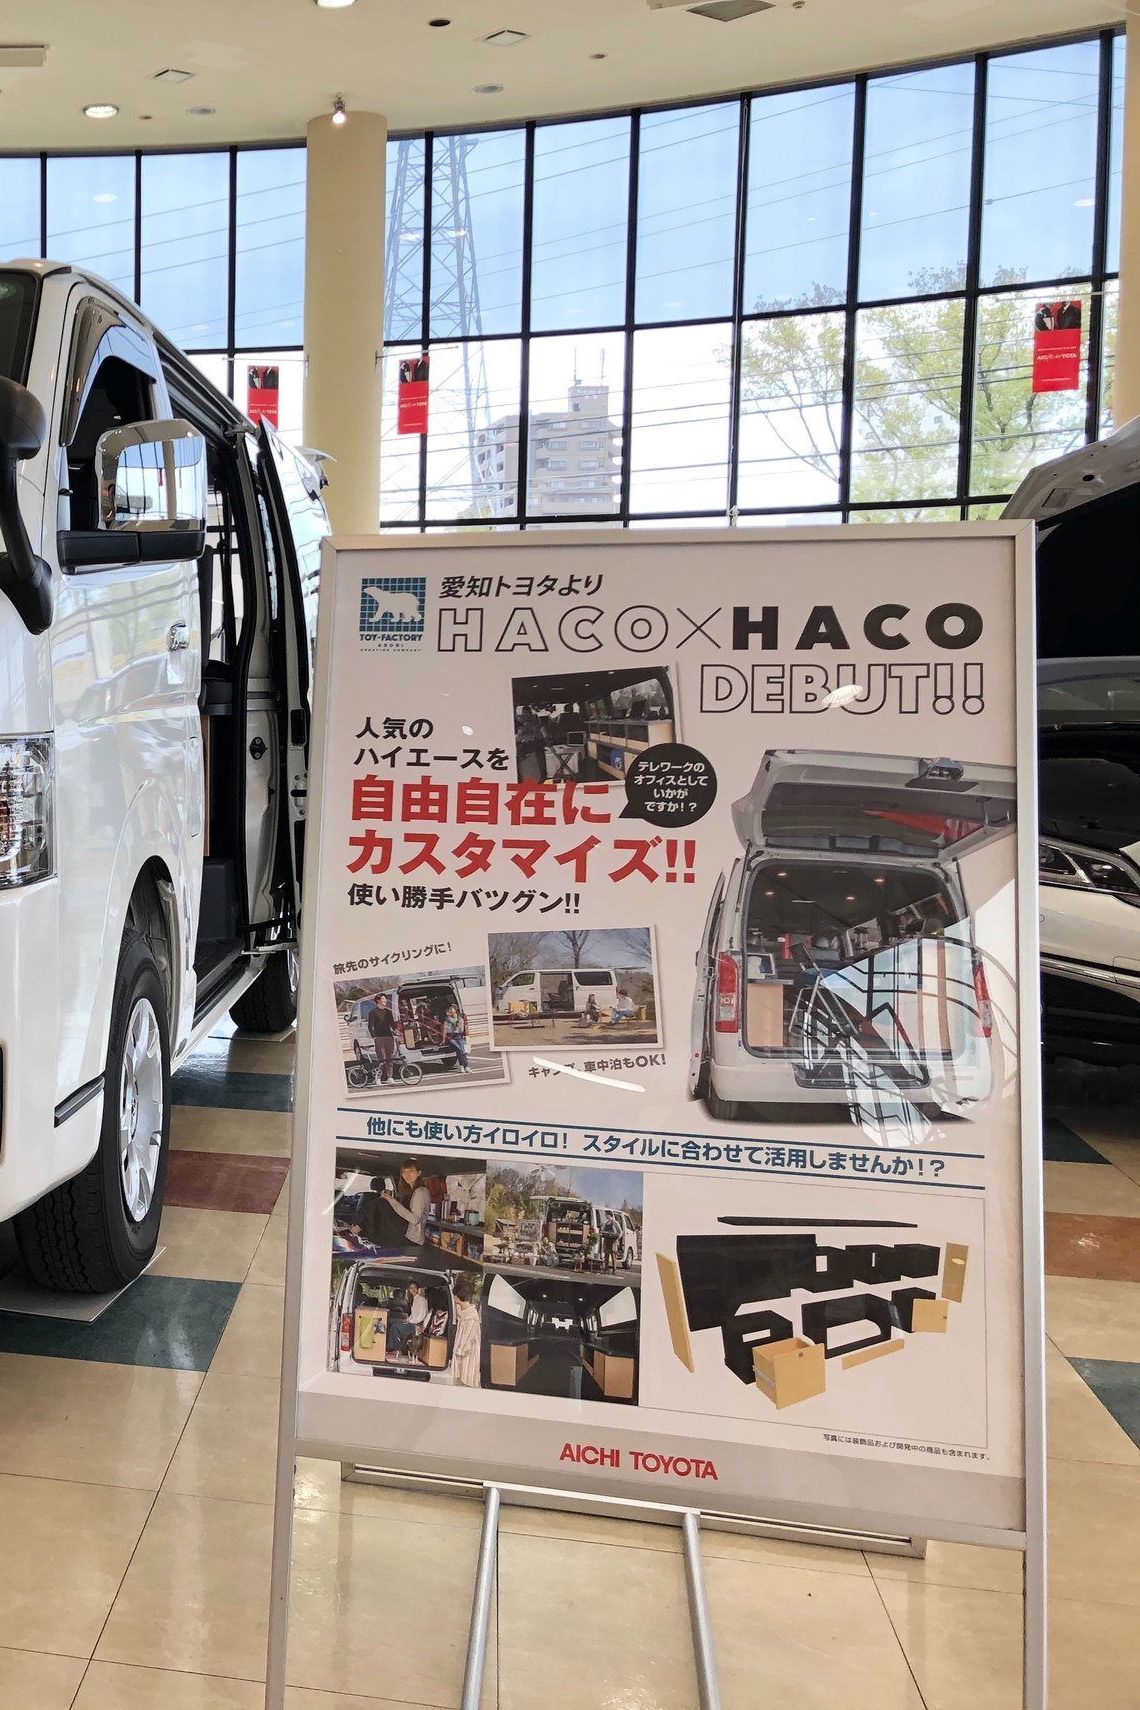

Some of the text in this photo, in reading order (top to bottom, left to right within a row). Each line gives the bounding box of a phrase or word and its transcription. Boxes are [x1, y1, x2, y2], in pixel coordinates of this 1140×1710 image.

[438, 573, 604, 599] 愛知トヨタより
[359, 633, 423, 642] TOY-FACTORY
[700, 663, 985, 715] DEBUT!!
[355, 716, 434, 740] 人気の
[353, 746, 510, 771] ハイエースを
[637, 761, 705, 773] テレワークの
[633, 774, 709, 786] オフィスとして
[653, 787, 689, 799] いかが
[351, 773, 612, 826] 自由自在に
[644, 801, 698, 812] ですか!?
[346, 829, 696, 884] カスタマイズ!!
[347, 883, 581, 915] 使い勝手バツグン!!
[332, 941, 453, 975] 旅先のサイクリングに!
[366, 1116, 945, 1178] 他にも使い方イロイロ! スタイルに合わせて活用しませんか!?
[822, 1433, 991, 1461] 写真には装飾品および開発中の商品も含まれます。
[559, 1442, 719, 1481] AICHI TOYOTA
